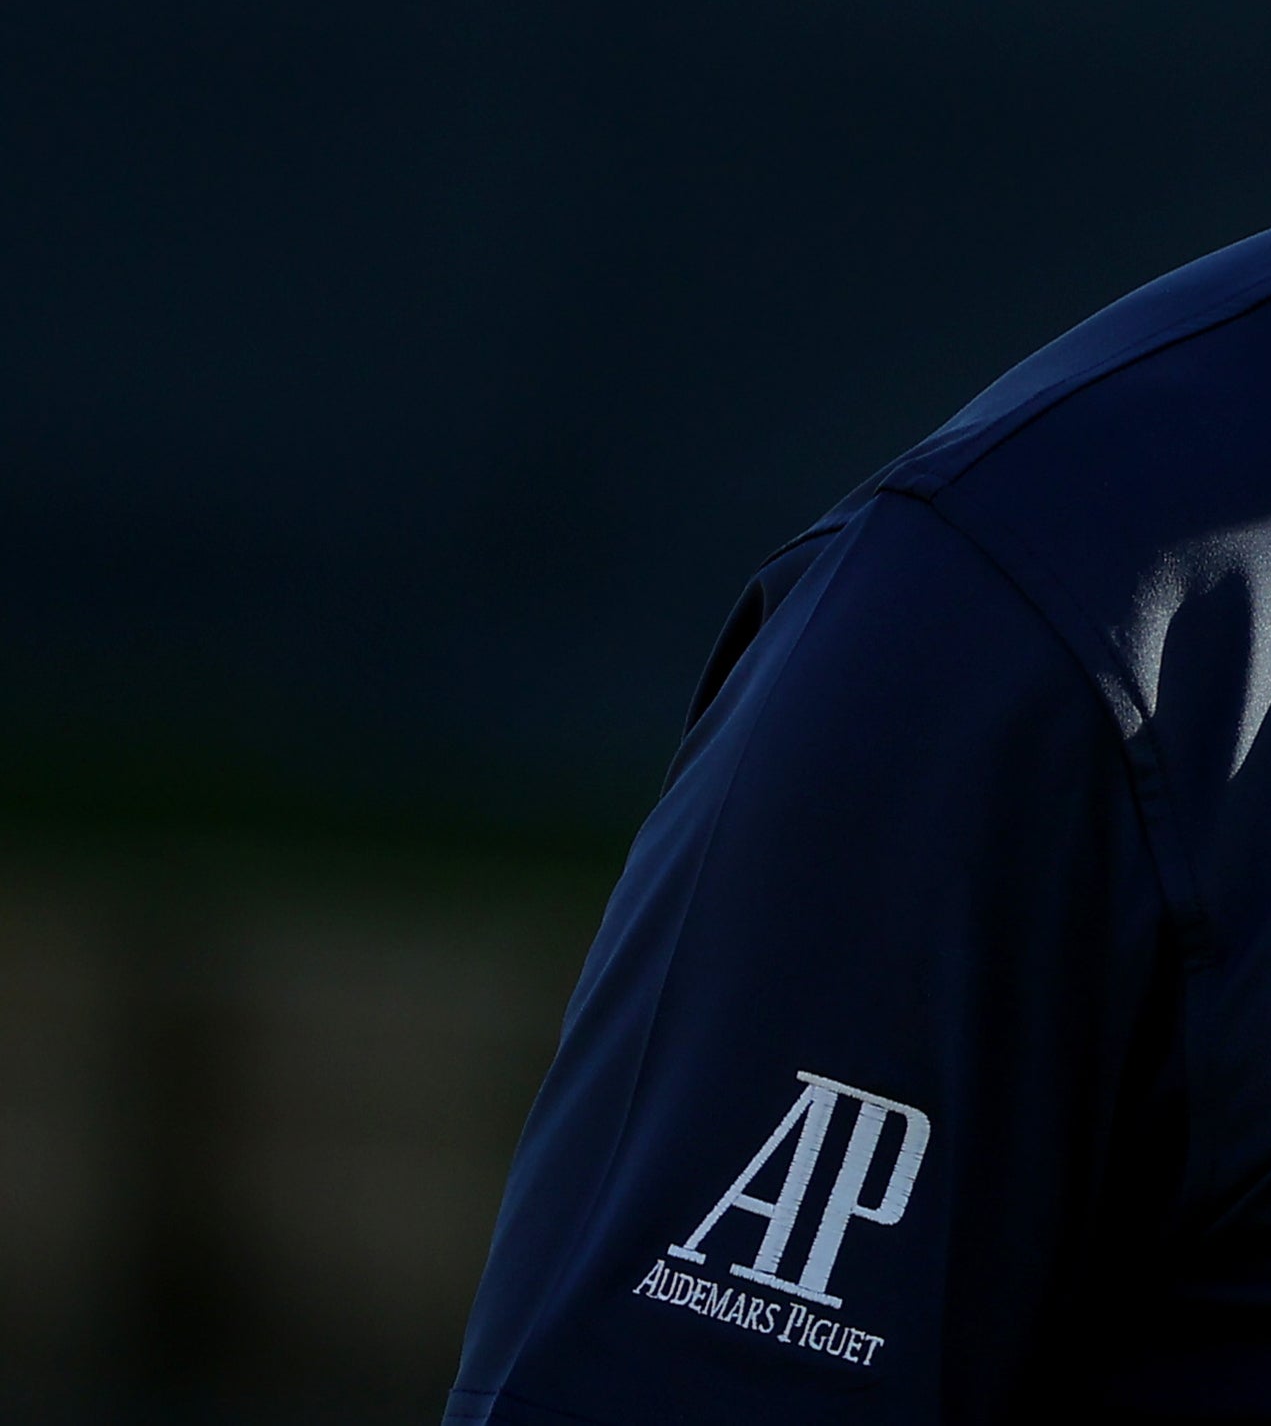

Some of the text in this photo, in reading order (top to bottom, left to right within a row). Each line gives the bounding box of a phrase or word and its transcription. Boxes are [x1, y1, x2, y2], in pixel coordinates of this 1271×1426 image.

[667, 1070, 931, 1310] AP
[632, 1259, 885, 1367] AUDEMARS PIGUET
